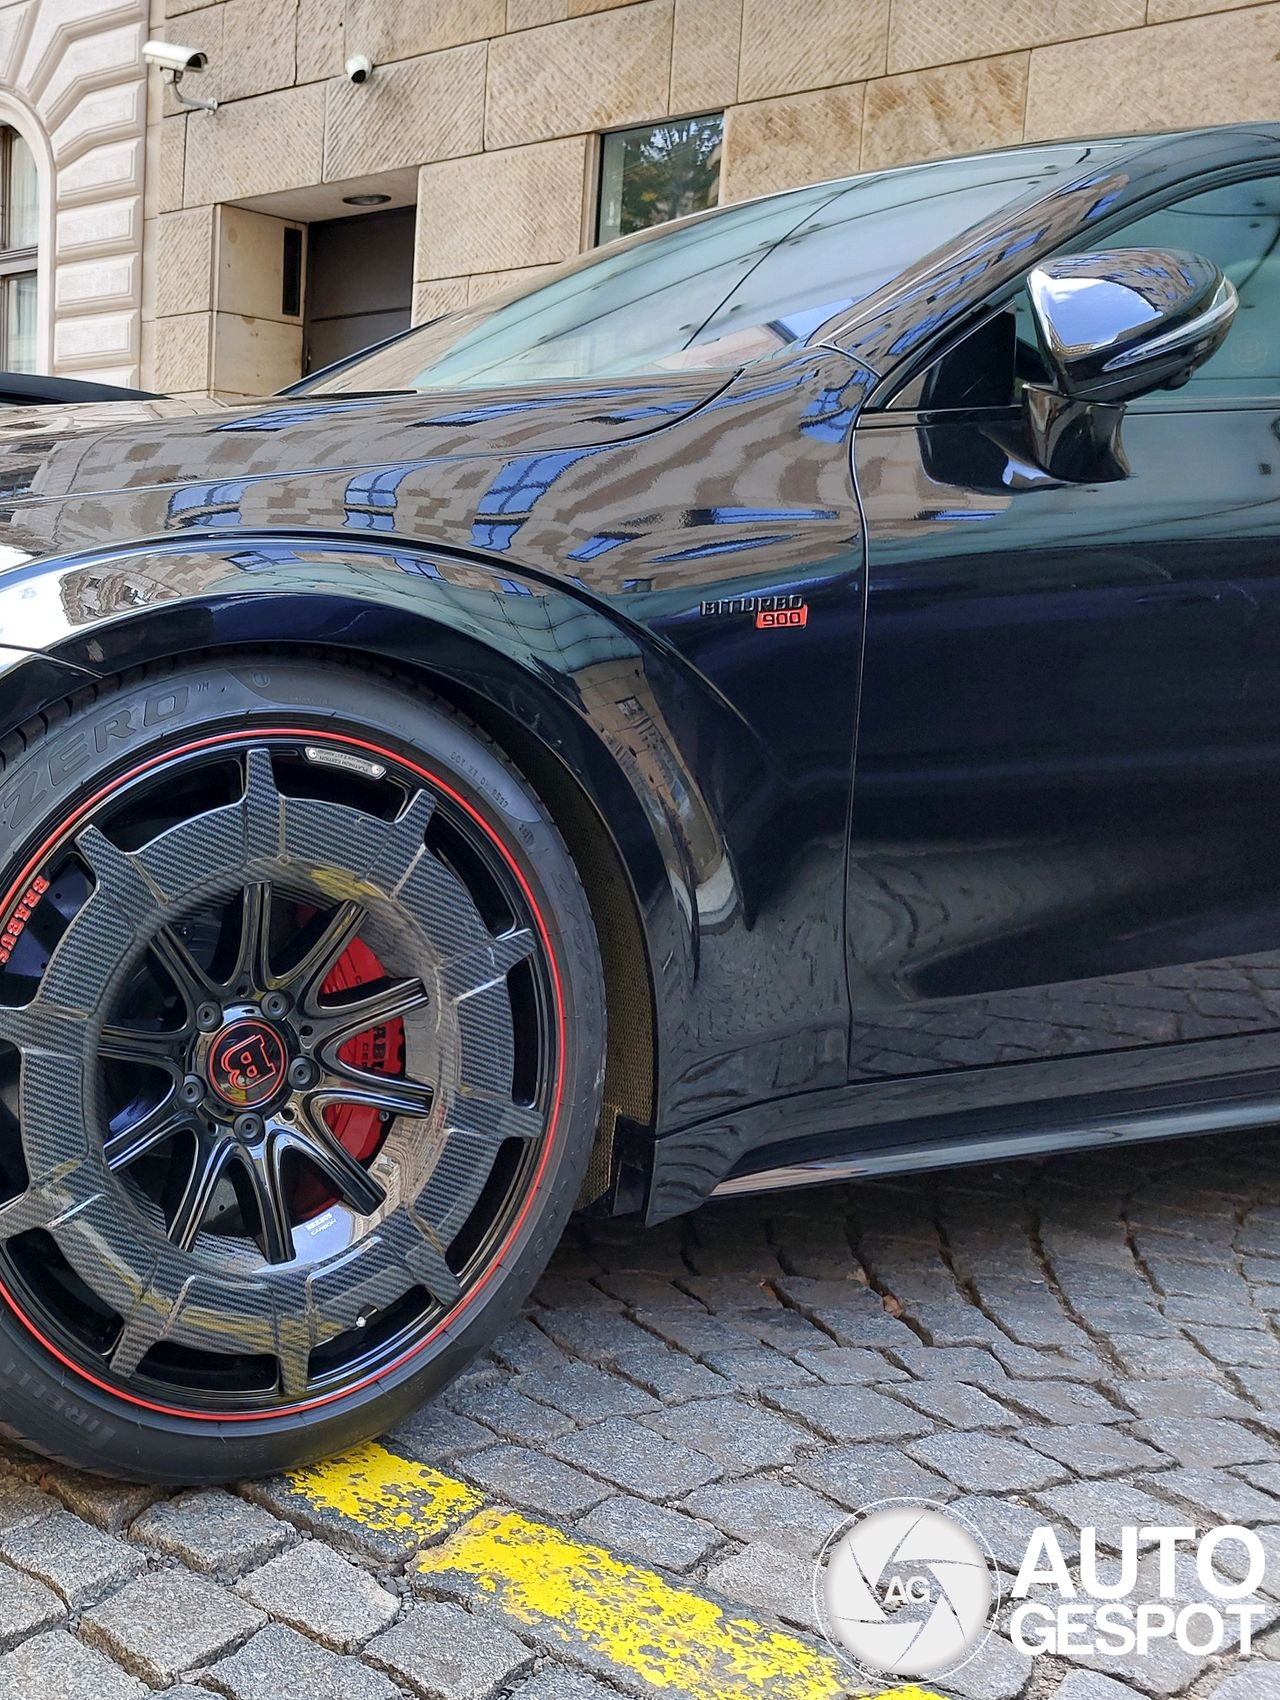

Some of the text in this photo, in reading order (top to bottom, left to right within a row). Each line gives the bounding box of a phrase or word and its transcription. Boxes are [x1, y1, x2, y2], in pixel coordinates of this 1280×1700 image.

[700, 594, 803, 616] BITURBO
[762, 611, 801, 626] 900
[4, 686, 189, 829] ZERO
[221, 1034, 276, 1090] B
